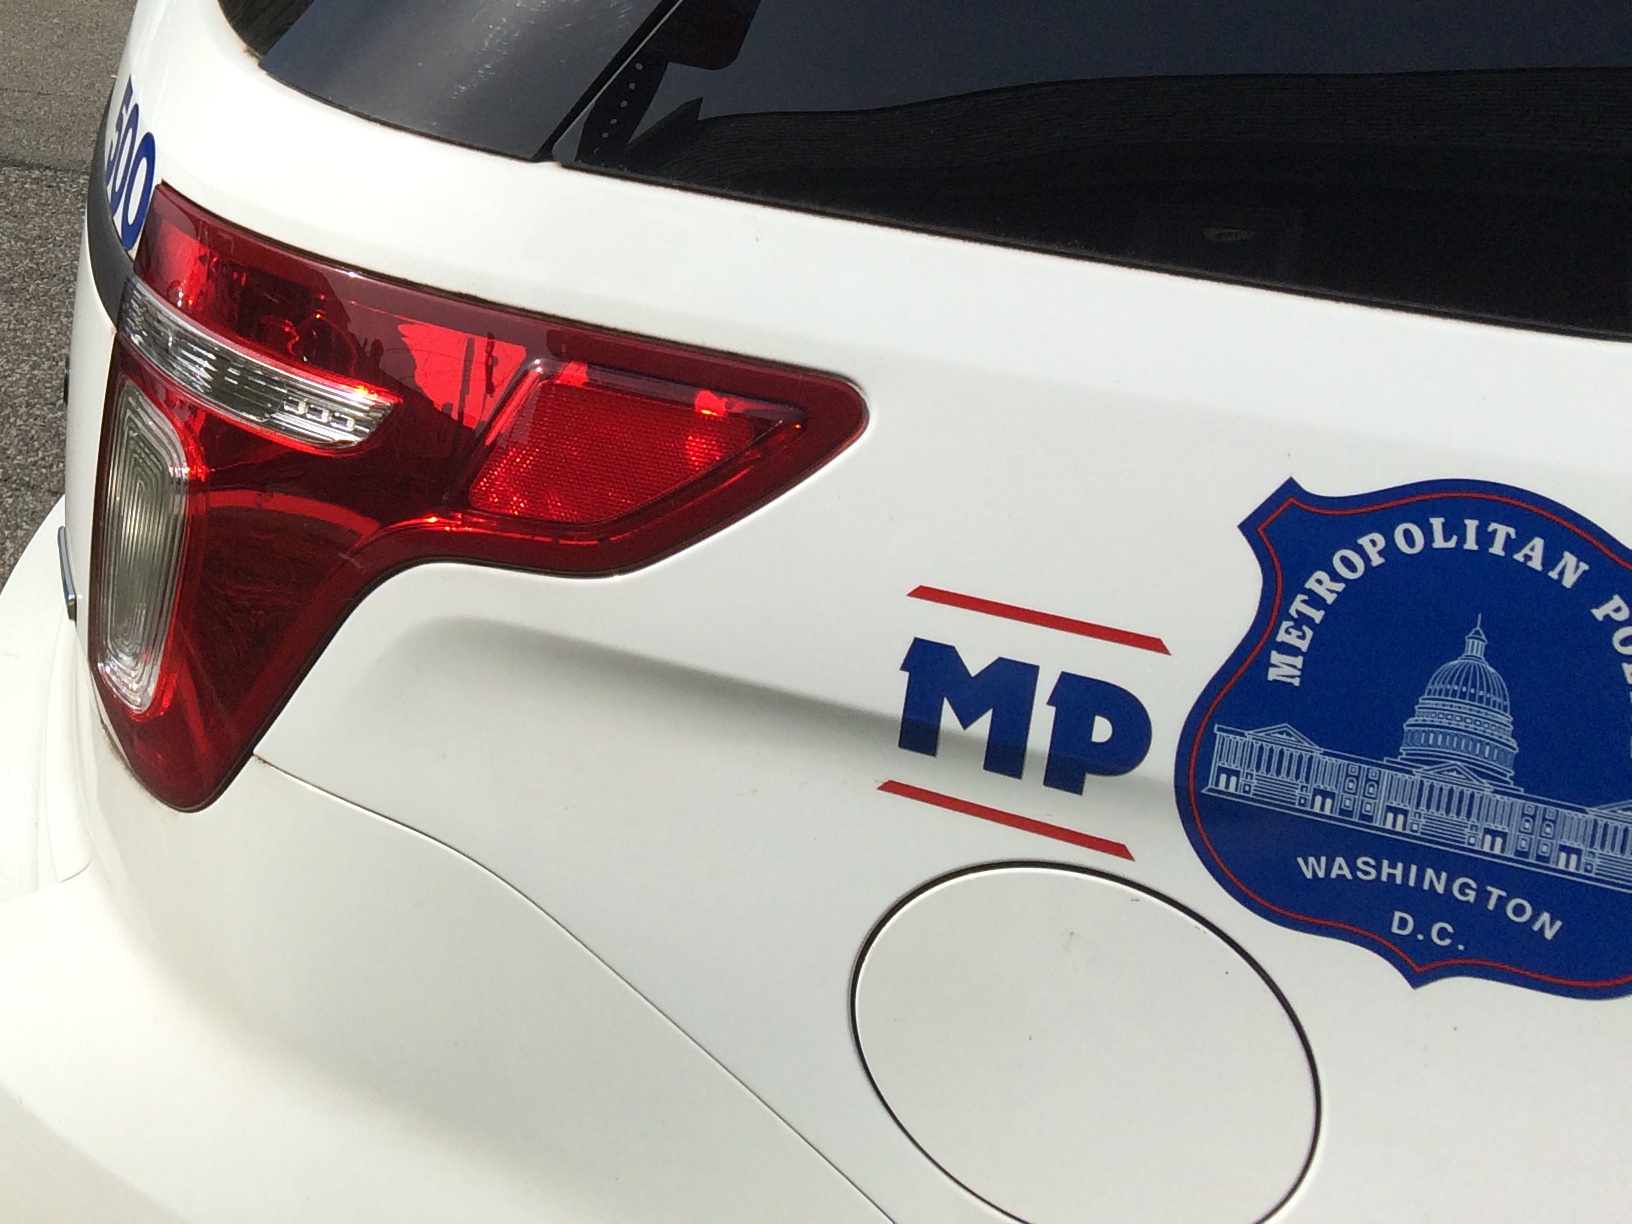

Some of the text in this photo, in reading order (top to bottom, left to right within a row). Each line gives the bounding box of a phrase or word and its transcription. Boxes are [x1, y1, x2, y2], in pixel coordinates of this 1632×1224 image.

[1267, 516, 1590, 686] METROPOLITAN
[898, 636, 1152, 796] MP
[1296, 854, 1564, 941] WASHINGTON
[1390, 910, 1465, 950] D.C.
